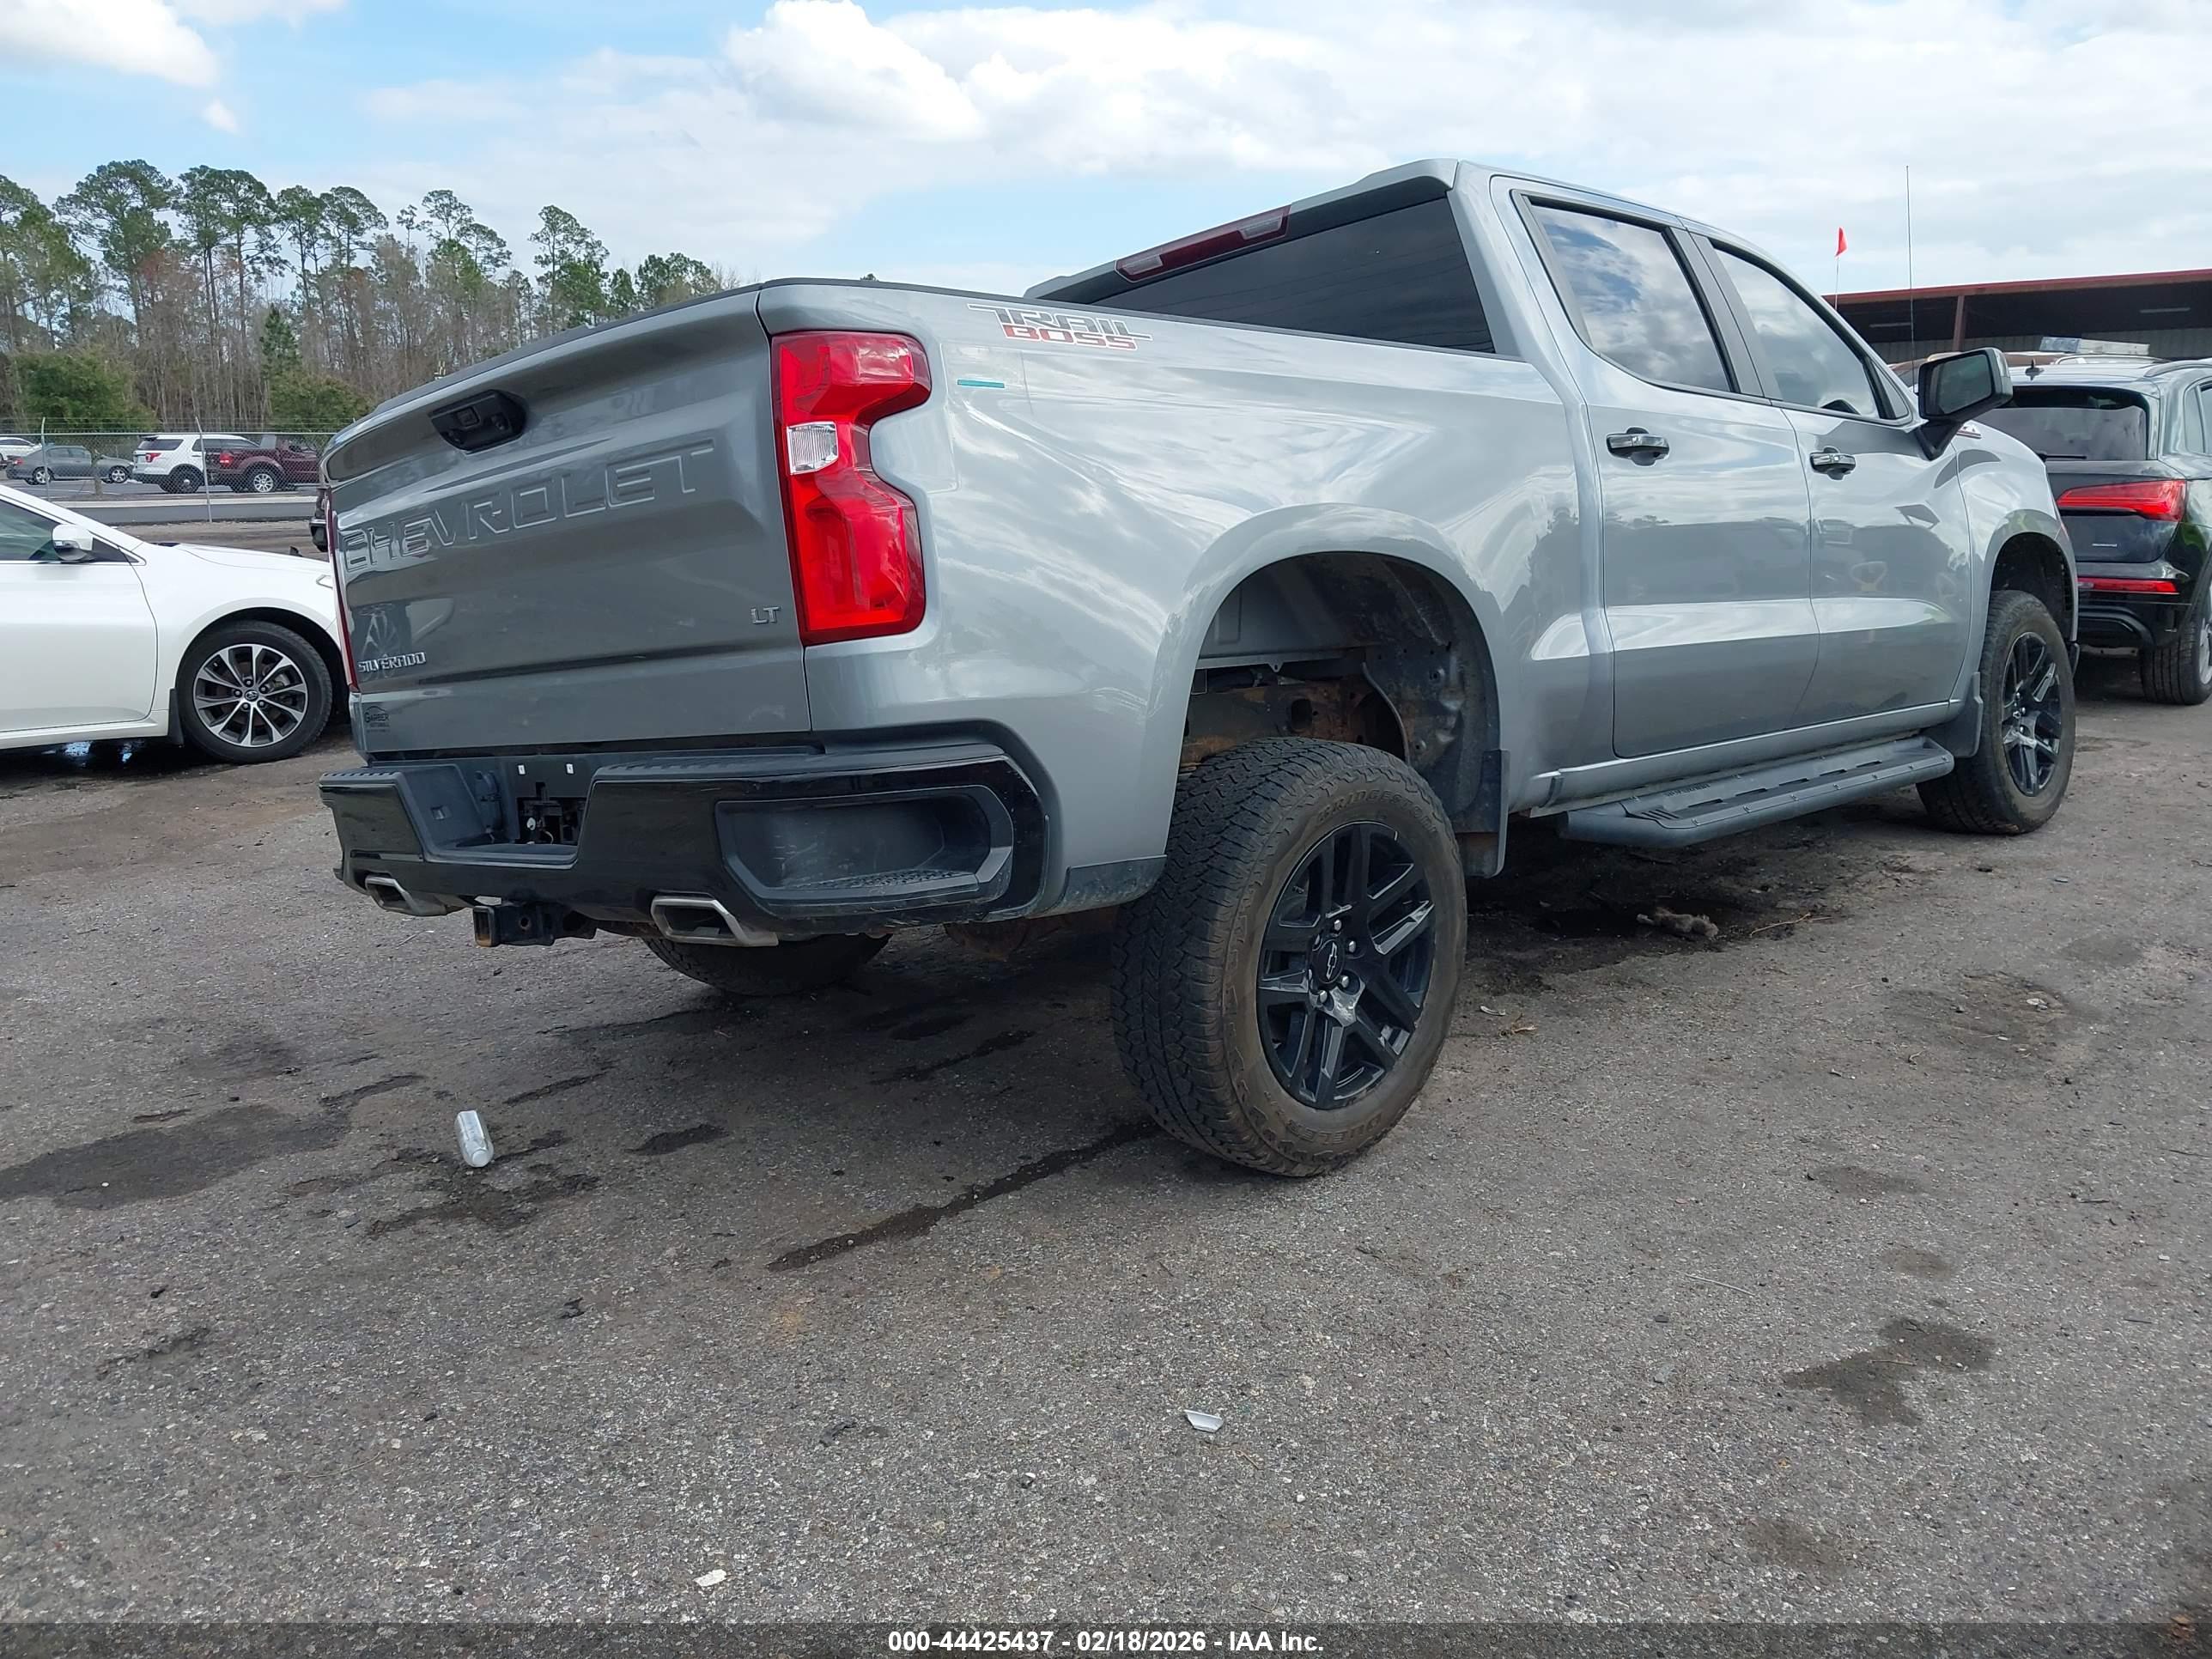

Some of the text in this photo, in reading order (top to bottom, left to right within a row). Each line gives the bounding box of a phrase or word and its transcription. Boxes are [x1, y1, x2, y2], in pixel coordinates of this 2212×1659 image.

[968, 303, 1153, 341] TRAIL
[1002, 324, 1138, 350] BOSS
[342, 439, 715, 573] CHEVROLET
[750, 605, 781, 624] LT
[357, 651, 427, 672] SILVERADO
